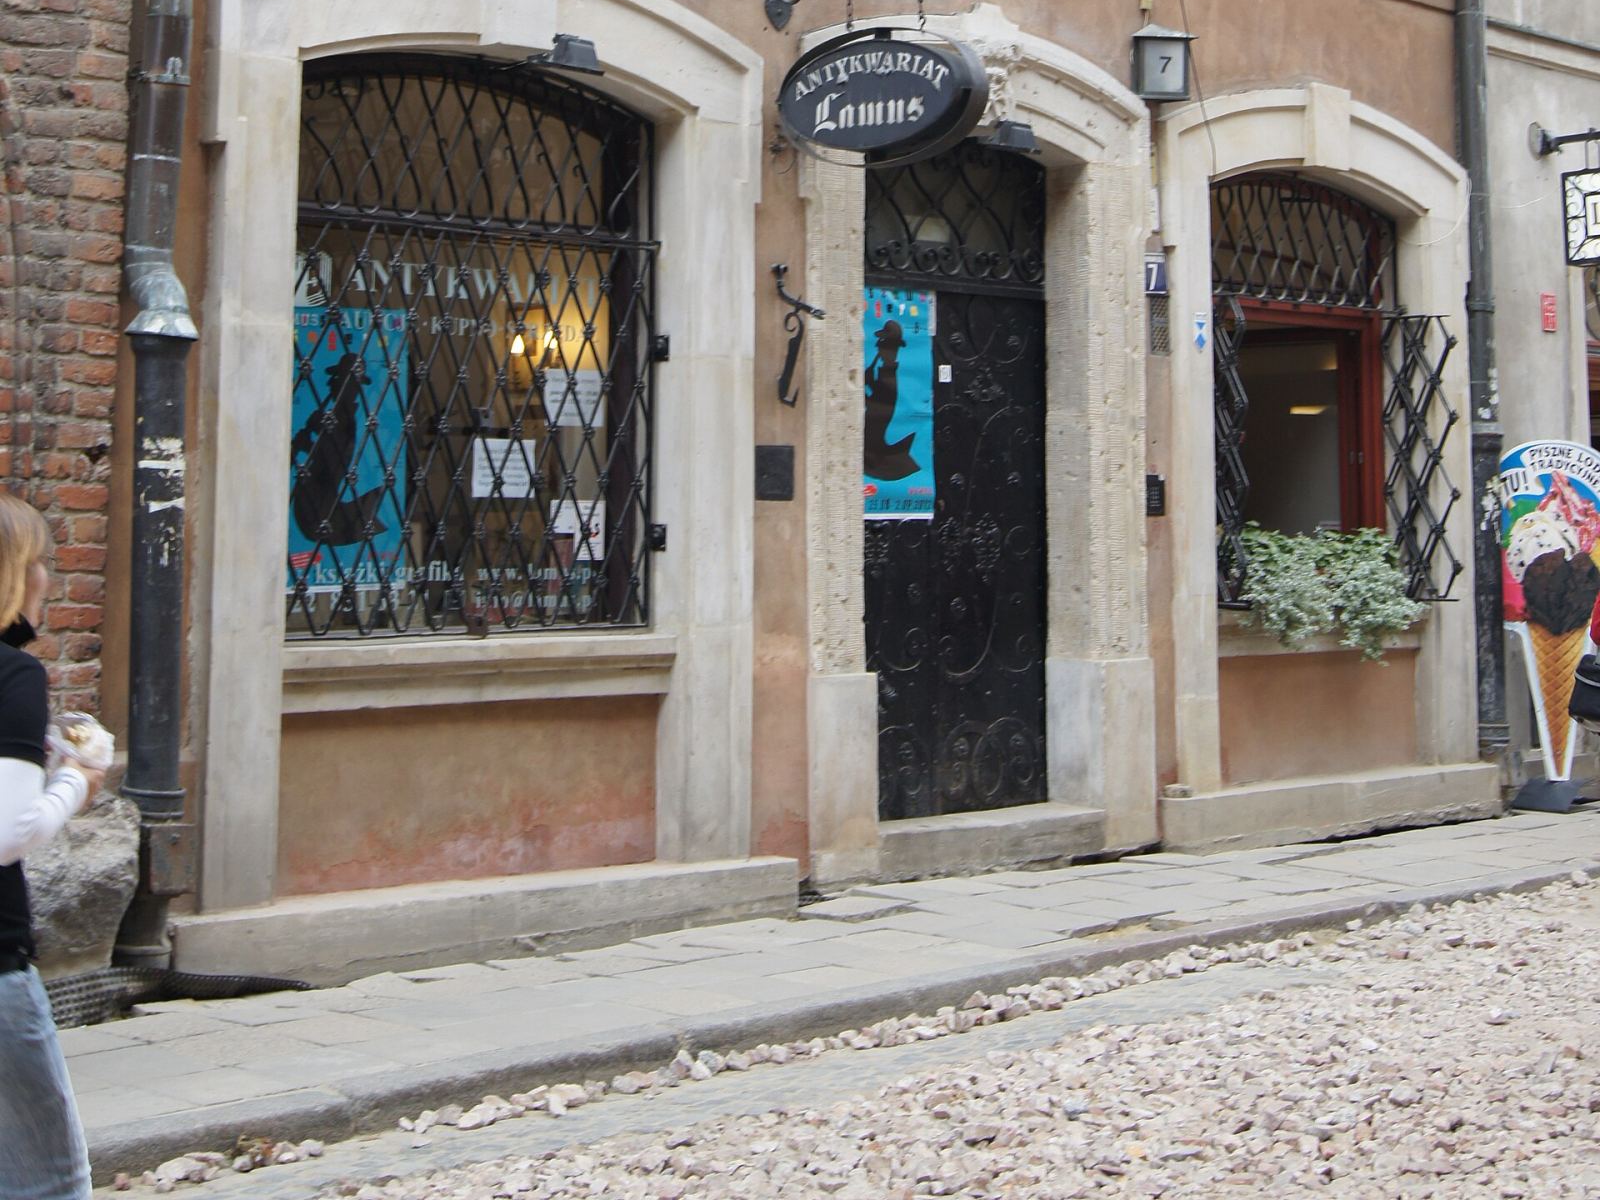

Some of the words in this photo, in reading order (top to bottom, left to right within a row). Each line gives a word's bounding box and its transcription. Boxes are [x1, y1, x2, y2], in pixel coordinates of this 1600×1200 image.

[795, 52, 949, 101] ANTYKWARIAT
[1159, 56, 1173, 74] 7
[812, 91, 925, 137] Lamus
[1147, 263, 1158, 290] 7
[1530, 447, 1573, 460] PYSZNE
[1500, 471, 1528, 497] TU!
